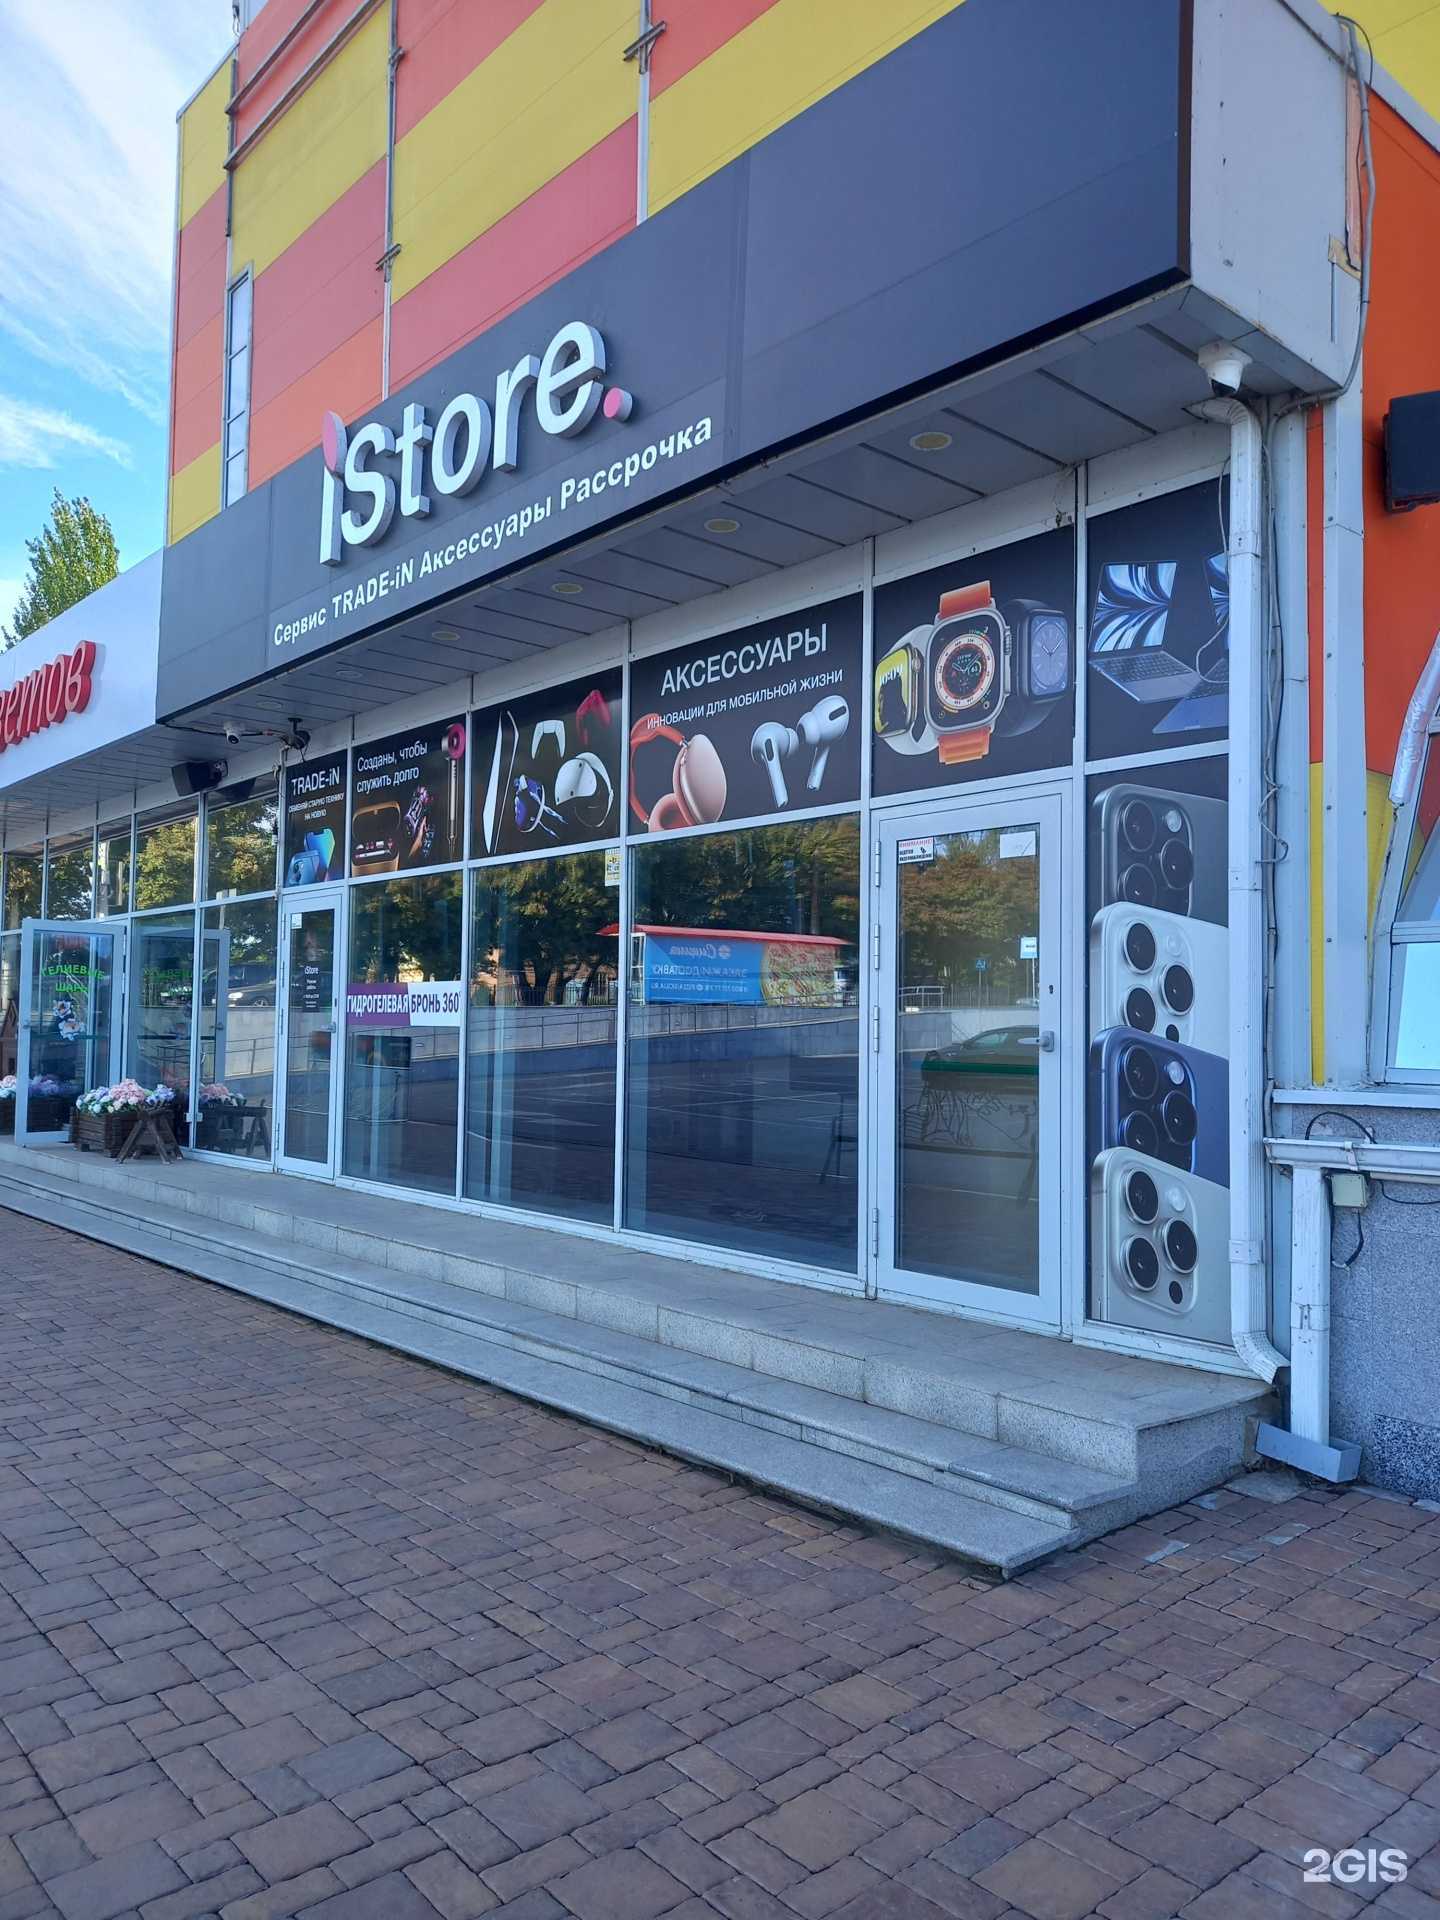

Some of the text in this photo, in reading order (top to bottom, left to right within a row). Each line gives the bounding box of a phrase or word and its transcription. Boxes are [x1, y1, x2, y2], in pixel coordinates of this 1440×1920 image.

[274, 607, 327, 646] Сервис
[419, 497, 552, 579] Аксессуары
[559, 416, 712, 511] Рассрочка
[660, 623, 828, 696] АКСЕССУАРЫ
[647, 668, 843, 730] ИННОВАЦИИ ДЛЯ МОБИЛЬНОЙ ЖИЗНИ
[357, 740, 428, 773] Созданы, чтобы
[356, 766, 420, 795] служить долго
[347, 994, 409, 1017] ГИДРОГЕЛЕВАЯ
[411, 993, 441, 1014] БРОНЬ
